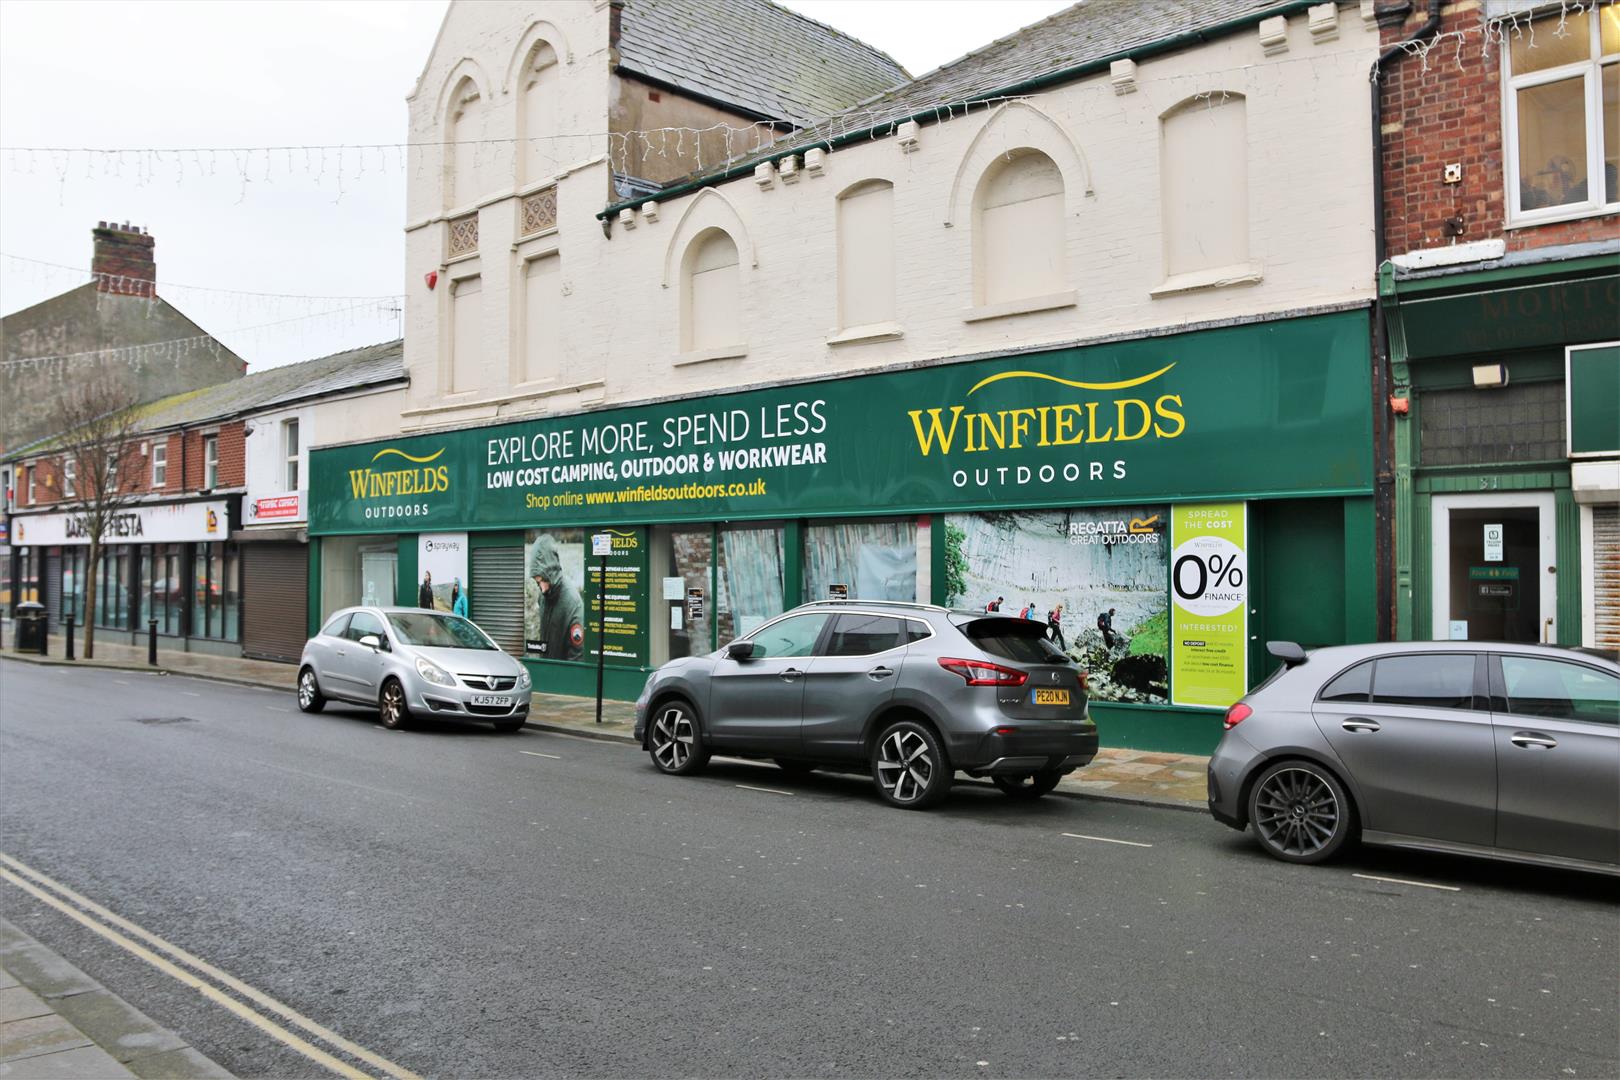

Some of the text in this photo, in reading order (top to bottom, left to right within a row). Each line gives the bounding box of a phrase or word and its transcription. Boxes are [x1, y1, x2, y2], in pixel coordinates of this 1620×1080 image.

[487, 400, 826, 466] EXPLORE MORE, SPEND LESS
[908, 394, 1186, 456] WINFIELDS
[487, 443, 827, 489] LOW COST CAMPING, OUTDOOR & WORKWEAR
[953, 460, 1126, 487] OUTDOORS
[349, 465, 449, 499] WINFIELDS
[525, 478, 766, 510] Shop online www.winfieldsoutdoors.co.uk
[365, 503, 429, 519] OUTDOORS
[1188, 510, 1228, 519] SPREAD
[1070, 520, 1127, 535] REGATTA
[1184, 520, 1233, 529] THE COST
[433, 542, 460, 552] sprayway
[1070, 533, 1158, 545] GREAT OUTDOORS
[1173, 554, 1243, 600] 0%
[474, 695, 494, 704] KJ57
[1036, 690, 1068, 702] PE20 NJN
